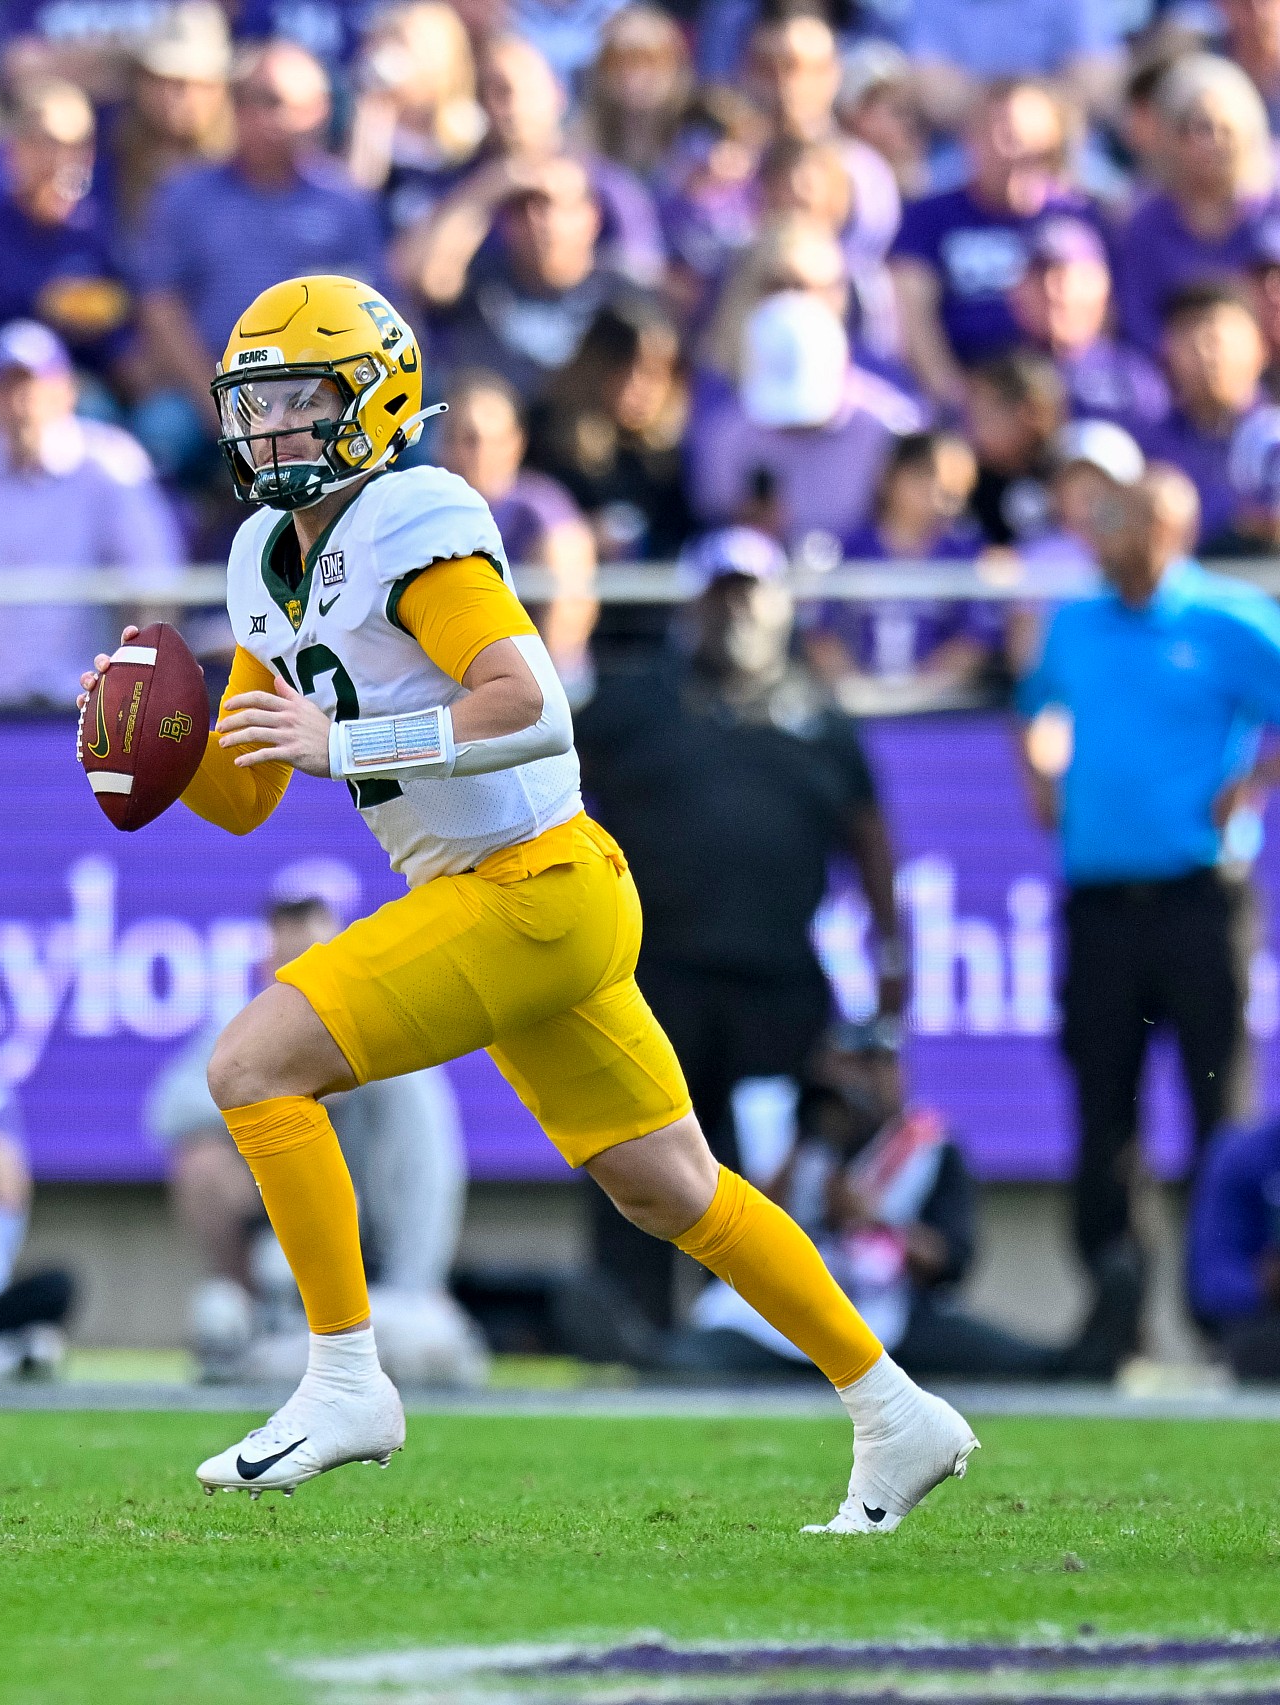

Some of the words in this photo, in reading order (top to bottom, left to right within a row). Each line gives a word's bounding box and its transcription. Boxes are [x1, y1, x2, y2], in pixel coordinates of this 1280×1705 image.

[238, 349, 268, 366] BEARS
[262, 471, 291, 482] Ridell
[321, 553, 343, 578] ONE
[249, 614, 268, 635] XII
[130, 681, 144, 714] ELITE
